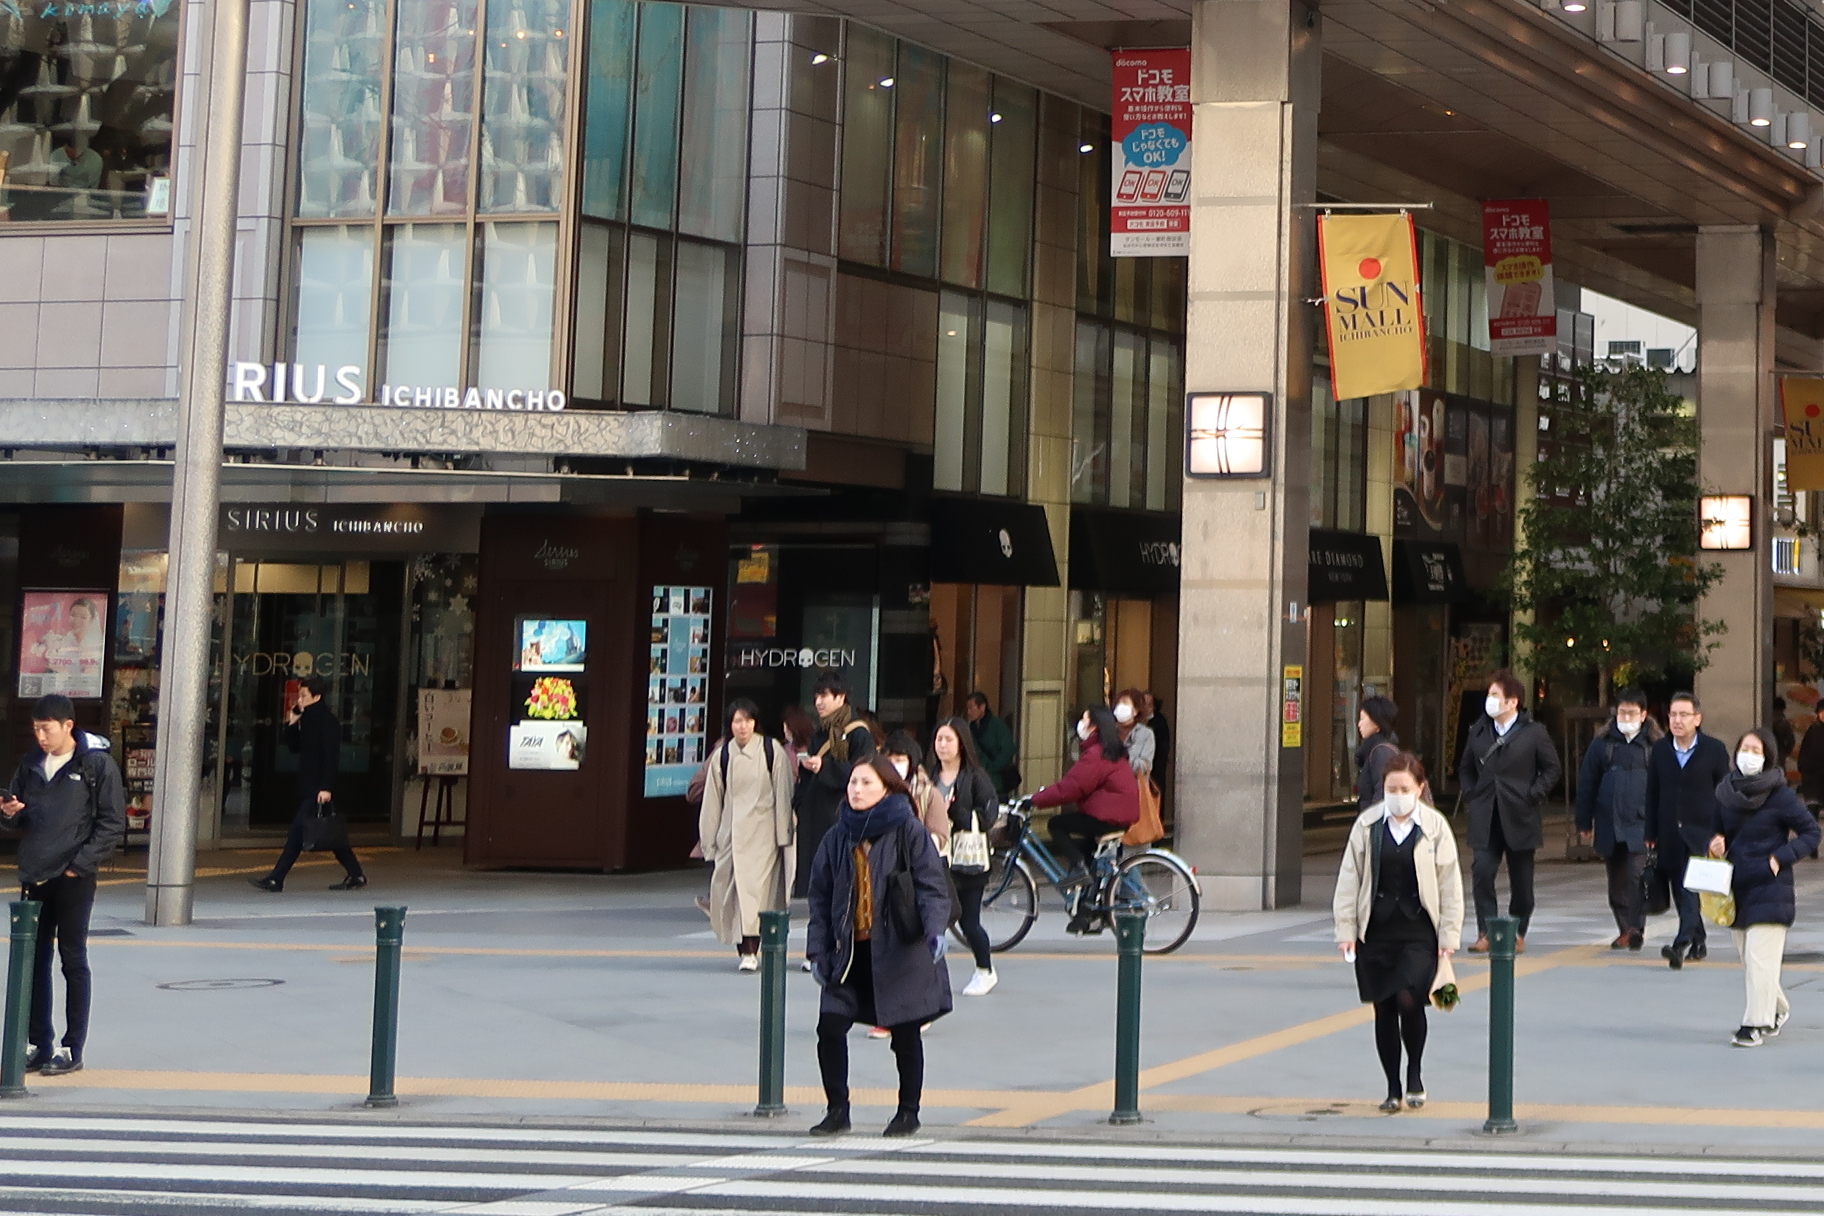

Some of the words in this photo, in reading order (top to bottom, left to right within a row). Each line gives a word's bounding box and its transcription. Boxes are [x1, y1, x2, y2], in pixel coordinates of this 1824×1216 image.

[1137, 68, 1173, 85] ドコモ
[1121, 84, 1190, 103] スマホ教室
[1141, 127, 1166, 141] ドコモ
[1132, 137, 1180, 153] じゃなくても
[1143, 149, 1167, 164] OK!
[1502, 214, 1531, 227] ドコモ
[1490, 225, 1545, 240] スマホ教室
[1335, 280, 1409, 315] SUN
[1339, 308, 1412, 333] MALL
[1339, 325, 1413, 343] ICHIBANCHO
[234, 361, 363, 406] RIUS
[381, 384, 566, 412] ICHIBANCHO
[227, 508, 319, 533] SIRIUS
[333, 519, 424, 534] ICHIBANCHO
[519, 735, 545, 749] TAYA
